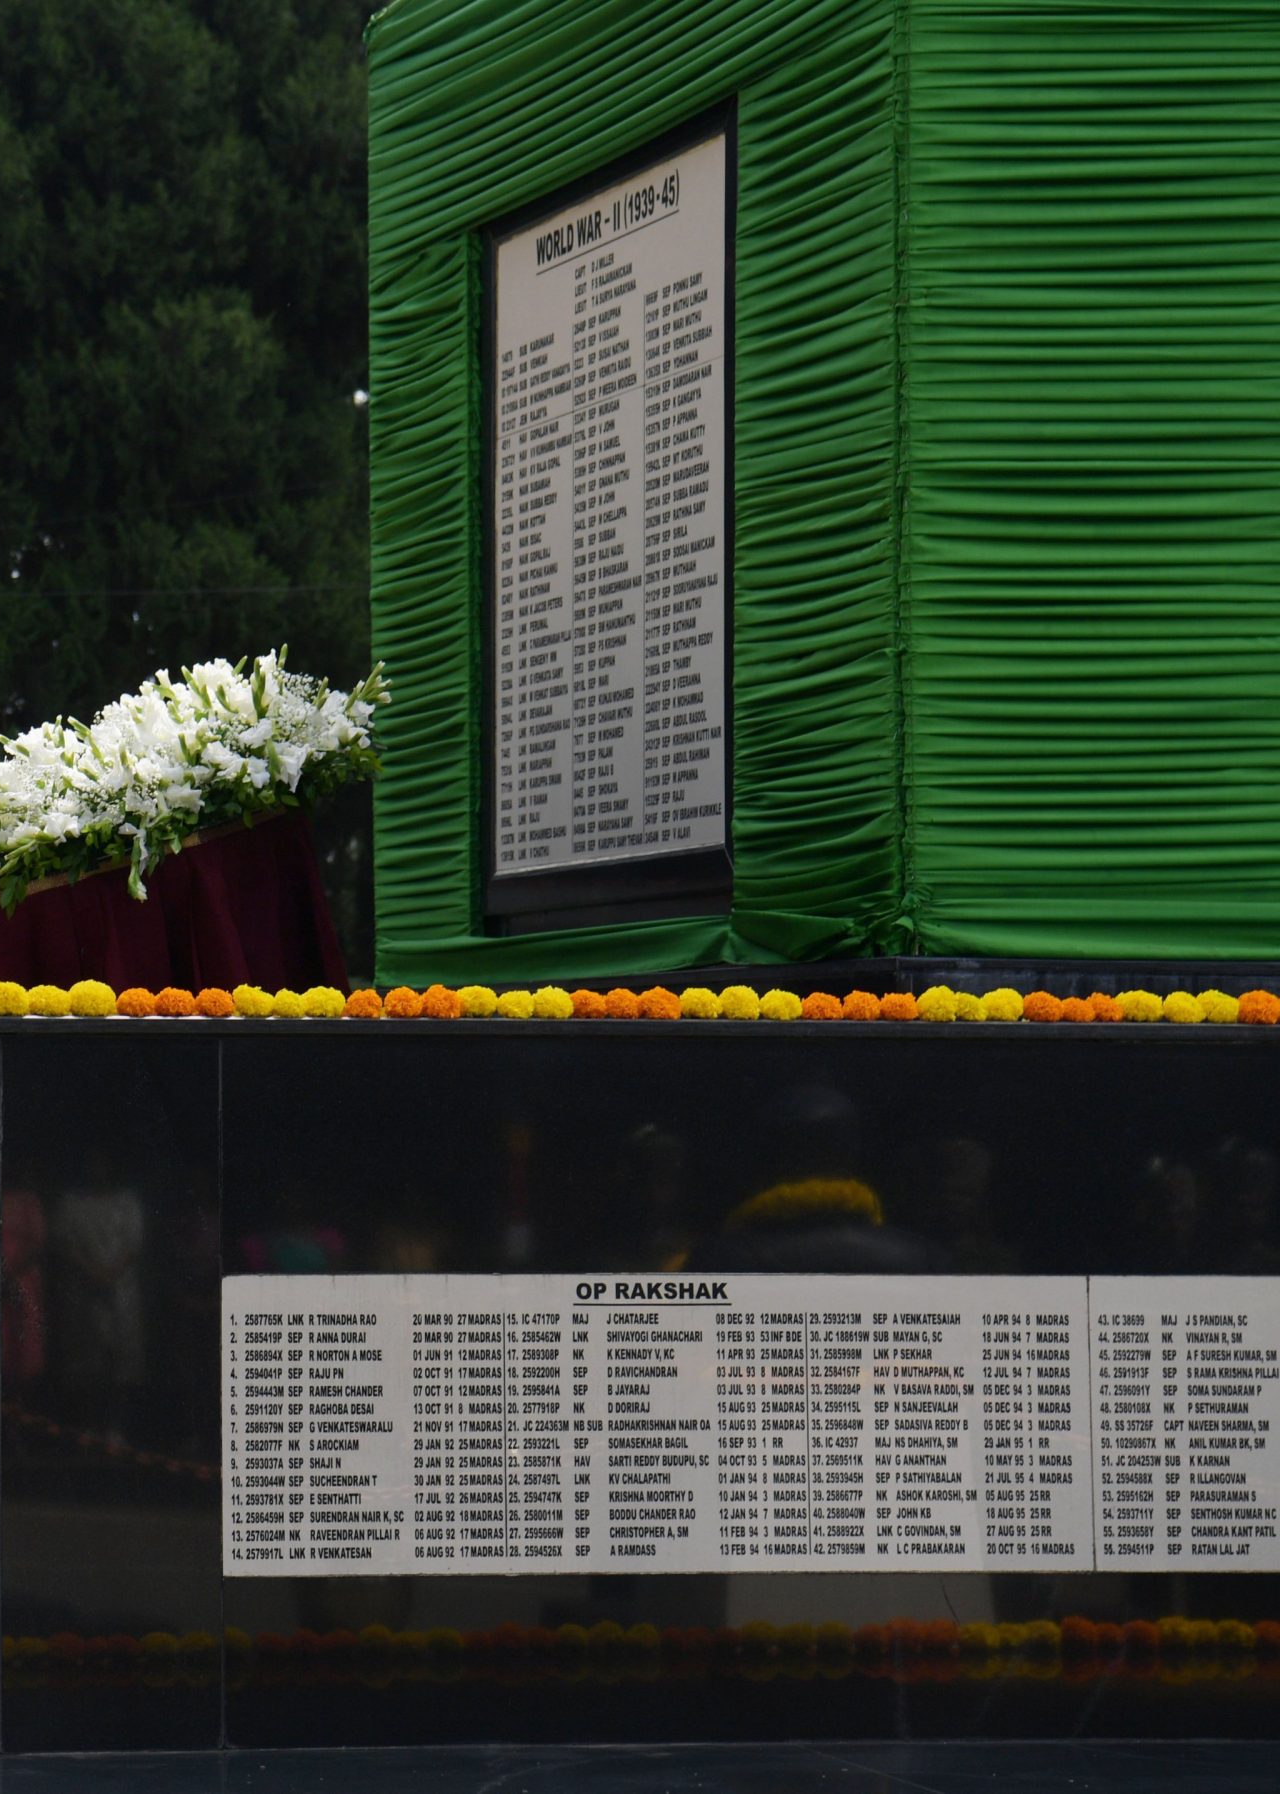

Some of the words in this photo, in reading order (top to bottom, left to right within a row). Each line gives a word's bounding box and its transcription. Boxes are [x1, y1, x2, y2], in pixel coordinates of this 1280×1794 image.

[537, 224, 574, 265] WORLD
[577, 211, 601, 247] WAR
[614, 201, 620, 231] II
[662, 286, 670, 299] SEP
[662, 342, 670, 355] SEP
[588, 353, 596, 365] SEP
[662, 361, 670, 373] SEP
[662, 380, 670, 393] SEP
[662, 417, 670, 431] SEP
[662, 680, 670, 692] SEP
[662, 716, 670, 728] SEP
[662, 791, 670, 804] SEP
[577, 1283, 606, 1300] OP
[616, 1283, 727, 1300] RAKSHAK
[230, 1314, 237, 1325] 1.
[245, 1314, 282, 1325] 2587765K
[288, 1314, 304, 1325] LNK
[309, 1314, 314, 1325] R
[317, 1314, 357, 1325] TRINADHA
[360, 1314, 376, 1325] RAO
[413, 1314, 422, 1325] 20
[425, 1314, 441, 1325] MAR
[444, 1314, 453, 1325] 90
[457, 1314, 466, 1325] 27
[468, 1314, 501, 1325] MADRAS
[809, 1313, 821, 1325] 29.
[823, 1313, 861, 1325] 2593213M
[873, 1313, 887, 1325] SEP
[893, 1313, 899, 1325] A
[982, 1314, 991, 1326] 10
[993, 1314, 1009, 1326] APR
[1011, 1314, 1021, 1326] 94
[1026, 1314, 1030, 1326] 8
[1036, 1314, 1069, 1326] MADRAS
[1098, 1315, 1109, 1326] 43.
[1112, 1315, 1120, 1326] IC
[1122, 1315, 1144, 1326] 38699
[1161, 1315, 1177, 1326] MAJ
[1186, 1315, 1190, 1326] J
[1193, 1315, 1197, 1326] S
[1200, 1315, 1235, 1328] PANDIAN,
[1238, 1315, 1248, 1326] SC
[507, 1332, 518, 1343] 16.
[522, 1332, 561, 1343] 2585462W
[573, 1332, 589, 1342] LNK
[607, 1331, 649, 1342] SHIVAYOGI
[651, 1331, 703, 1342] GHANACHARI
[716, 1332, 725, 1342] 19
[727, 1332, 743, 1342] FEB
[746, 1332, 755, 1342] 93
[760, 1332, 769, 1342] 53
[772, 1332, 784, 1342] INF
[786, 1332, 802, 1342] BDE
[231, 1422, 238, 1433] 7.
[245, 1422, 283, 1433] 2586979N
[288, 1422, 303, 1433] SEP
[310, 1422, 315, 1433] G
[317, 1421, 393, 1433] VENKATESWARALU
[414, 1421, 423, 1432] 21
[425, 1421, 442, 1432] NOV
[445, 1421, 453, 1432] 91
[459, 1420, 468, 1432] 17
[470, 1420, 502, 1432] MADRAS
[508, 1439, 519, 1450] 22.
[523, 1438, 560, 1449] 2593221L
[574, 1438, 589, 1449] SEP
[608, 1438, 662, 1449] SOMASEKHAR
[664, 1438, 688, 1449] BAGIL
[718, 1437, 727, 1448] 16
[730, 1437, 744, 1448] SEP
[748, 1437, 757, 1448] 93
[763, 1437, 766, 1448] 1
[772, 1437, 783, 1448] RR
[231, 1494, 243, 1505] 11.
[246, 1494, 283, 1505] 2593781X
[289, 1494, 304, 1505] SEP
[310, 1494, 315, 1504] E
[317, 1494, 361, 1504] SENTHATTI
[415, 1493, 423, 1504] 17
[426, 1493, 441, 1504] JUL
[446, 1493, 454, 1504] 92
[460, 1493, 468, 1503] 26
[470, 1492, 503, 1503] MADRAS
[1103, 1526, 1114, 1537] 55.
[1118, 1526, 1154, 1537] 2593658Y
[1167, 1526, 1182, 1537] SEP
[1191, 1526, 1229, 1537] CHANDRA
[1232, 1526, 1252, 1537] KANT
[1255, 1526, 1276, 1537] PATIL
